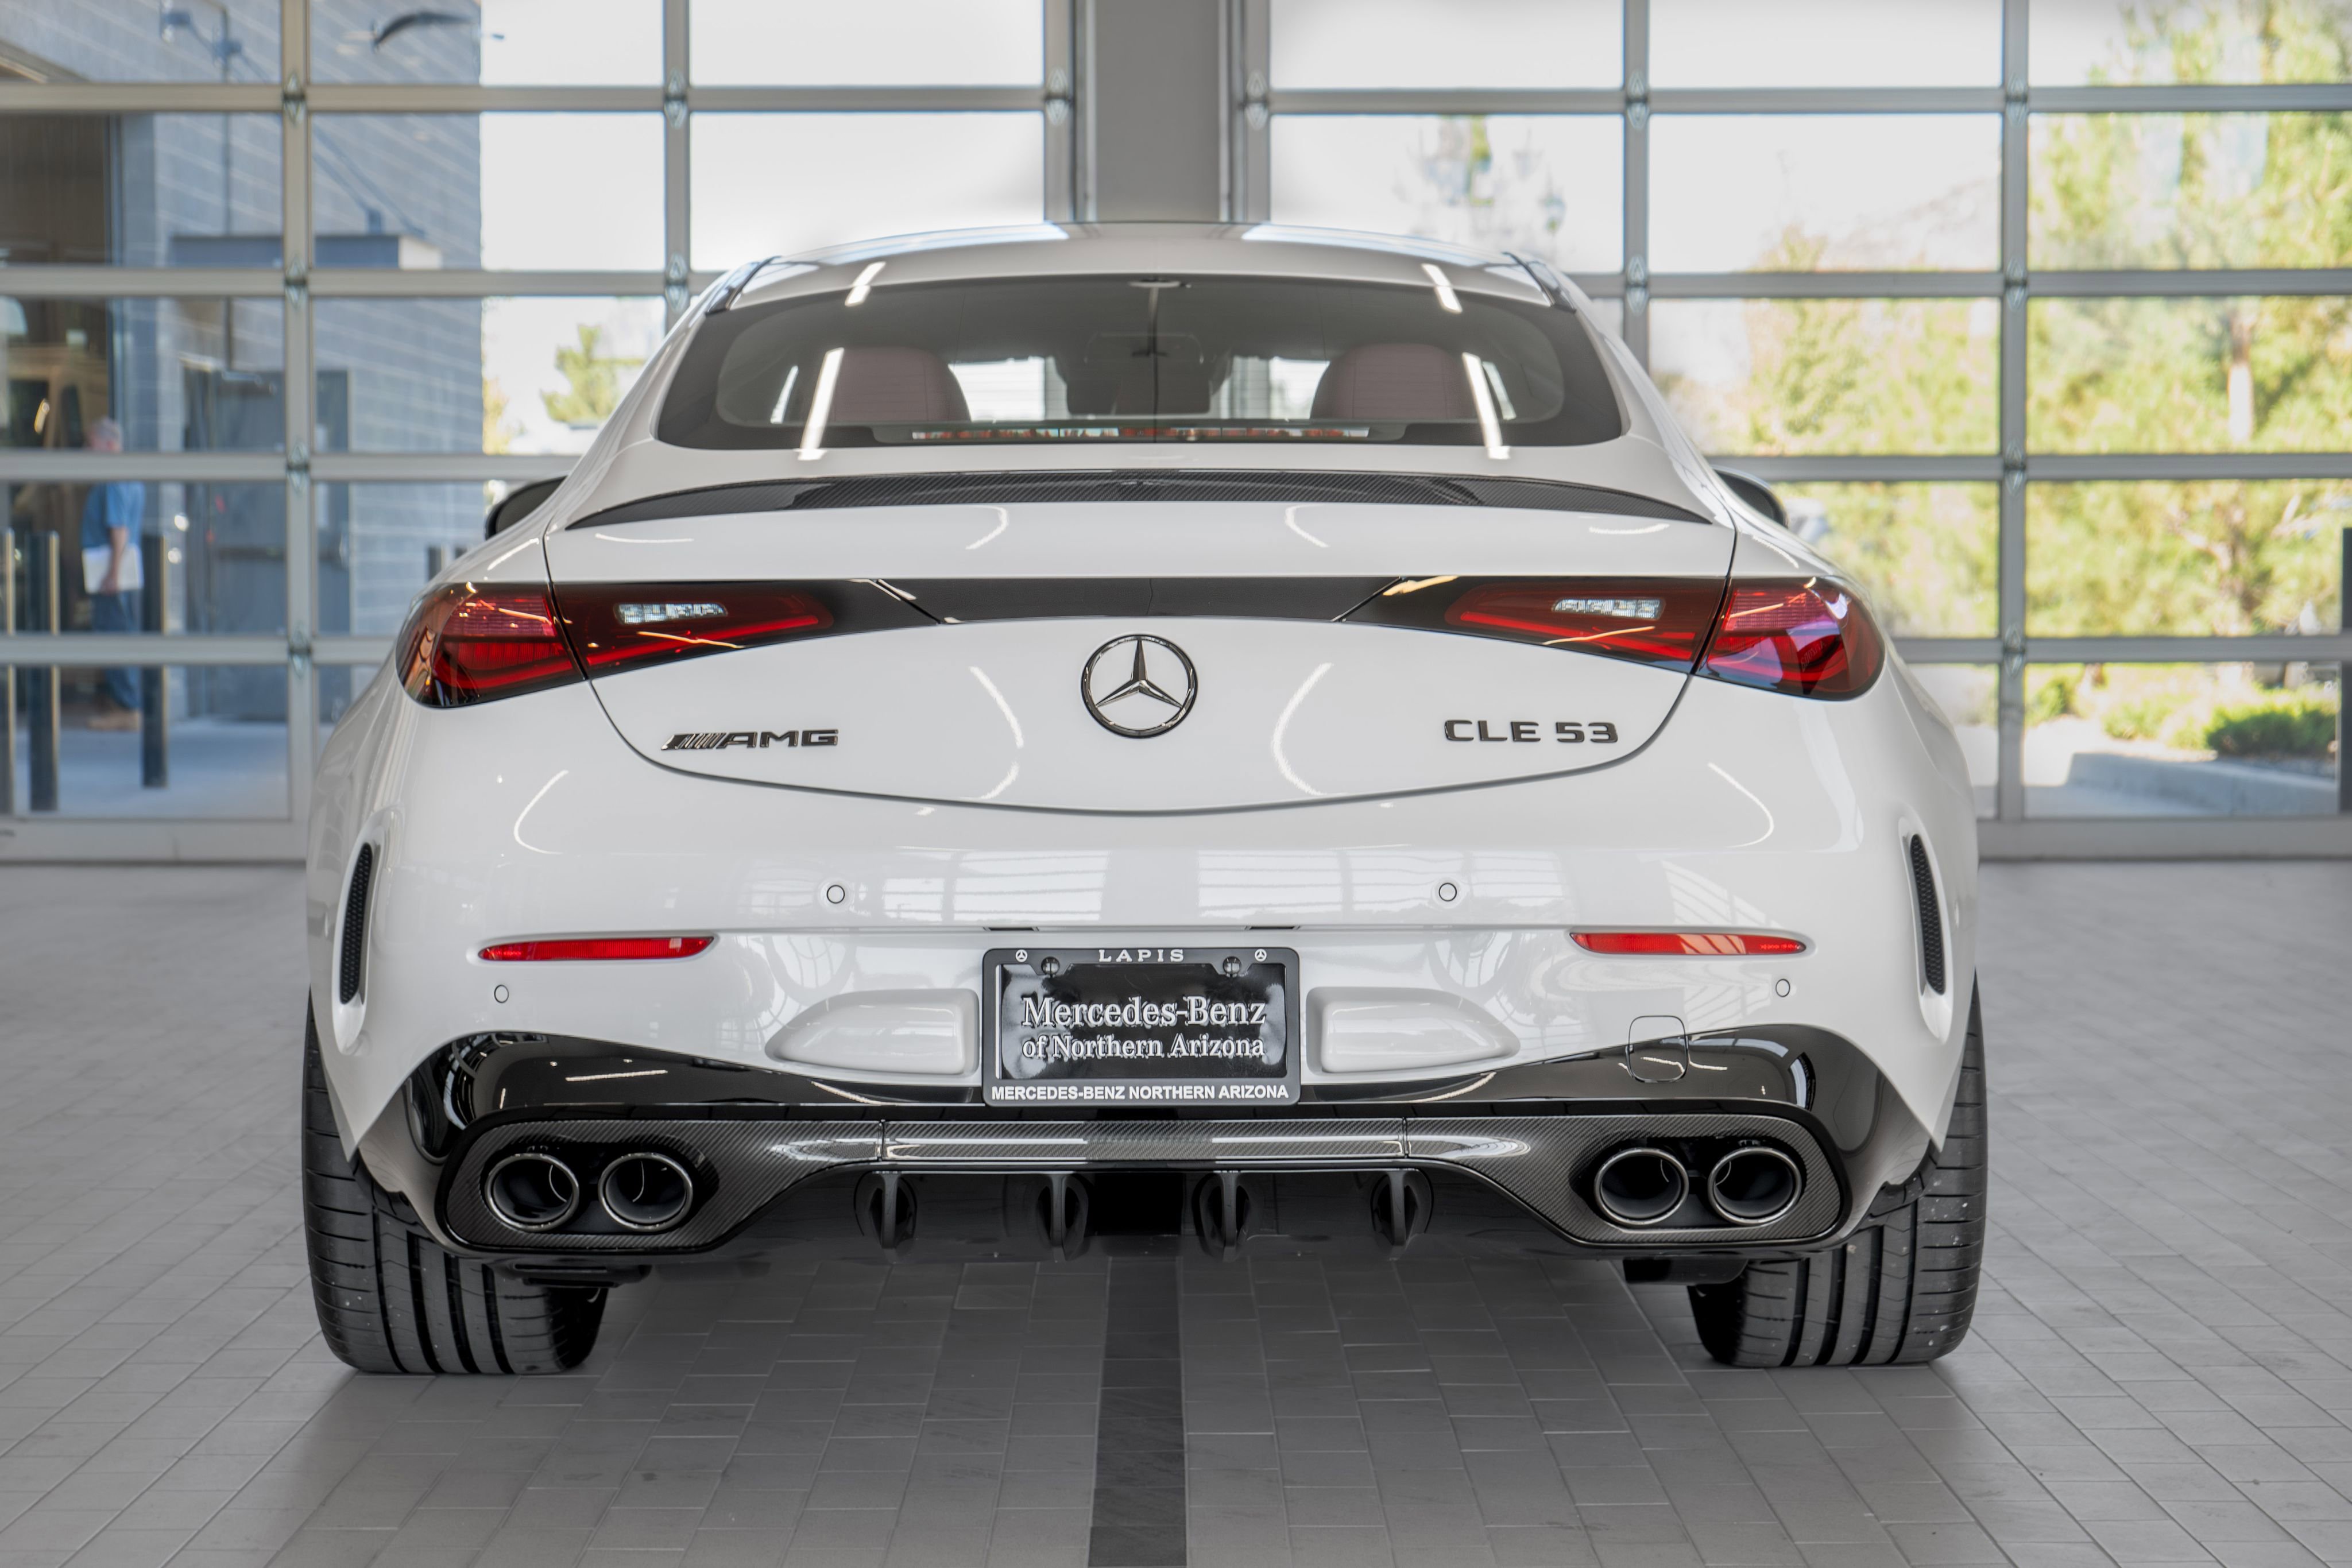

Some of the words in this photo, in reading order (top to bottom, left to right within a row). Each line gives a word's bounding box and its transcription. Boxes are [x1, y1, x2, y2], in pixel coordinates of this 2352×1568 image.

[1444, 720, 1541, 742] CLE
[1555, 722, 1618, 742] 53
[1098, 949, 1185, 962] LAPIS
[1022, 996, 1266, 1027] Mercedes-Benz
[1023, 1035, 1047, 1058] of
[1052, 1035, 1164, 1058] Northern
[1170, 1034, 1266, 1058] Arizona
[992, 1086, 1125, 1101] MERCEDES-BENZ
[1129, 1085, 1215, 1099] NORTHERN
[1218, 1085, 1289, 1099] ARIZONA
